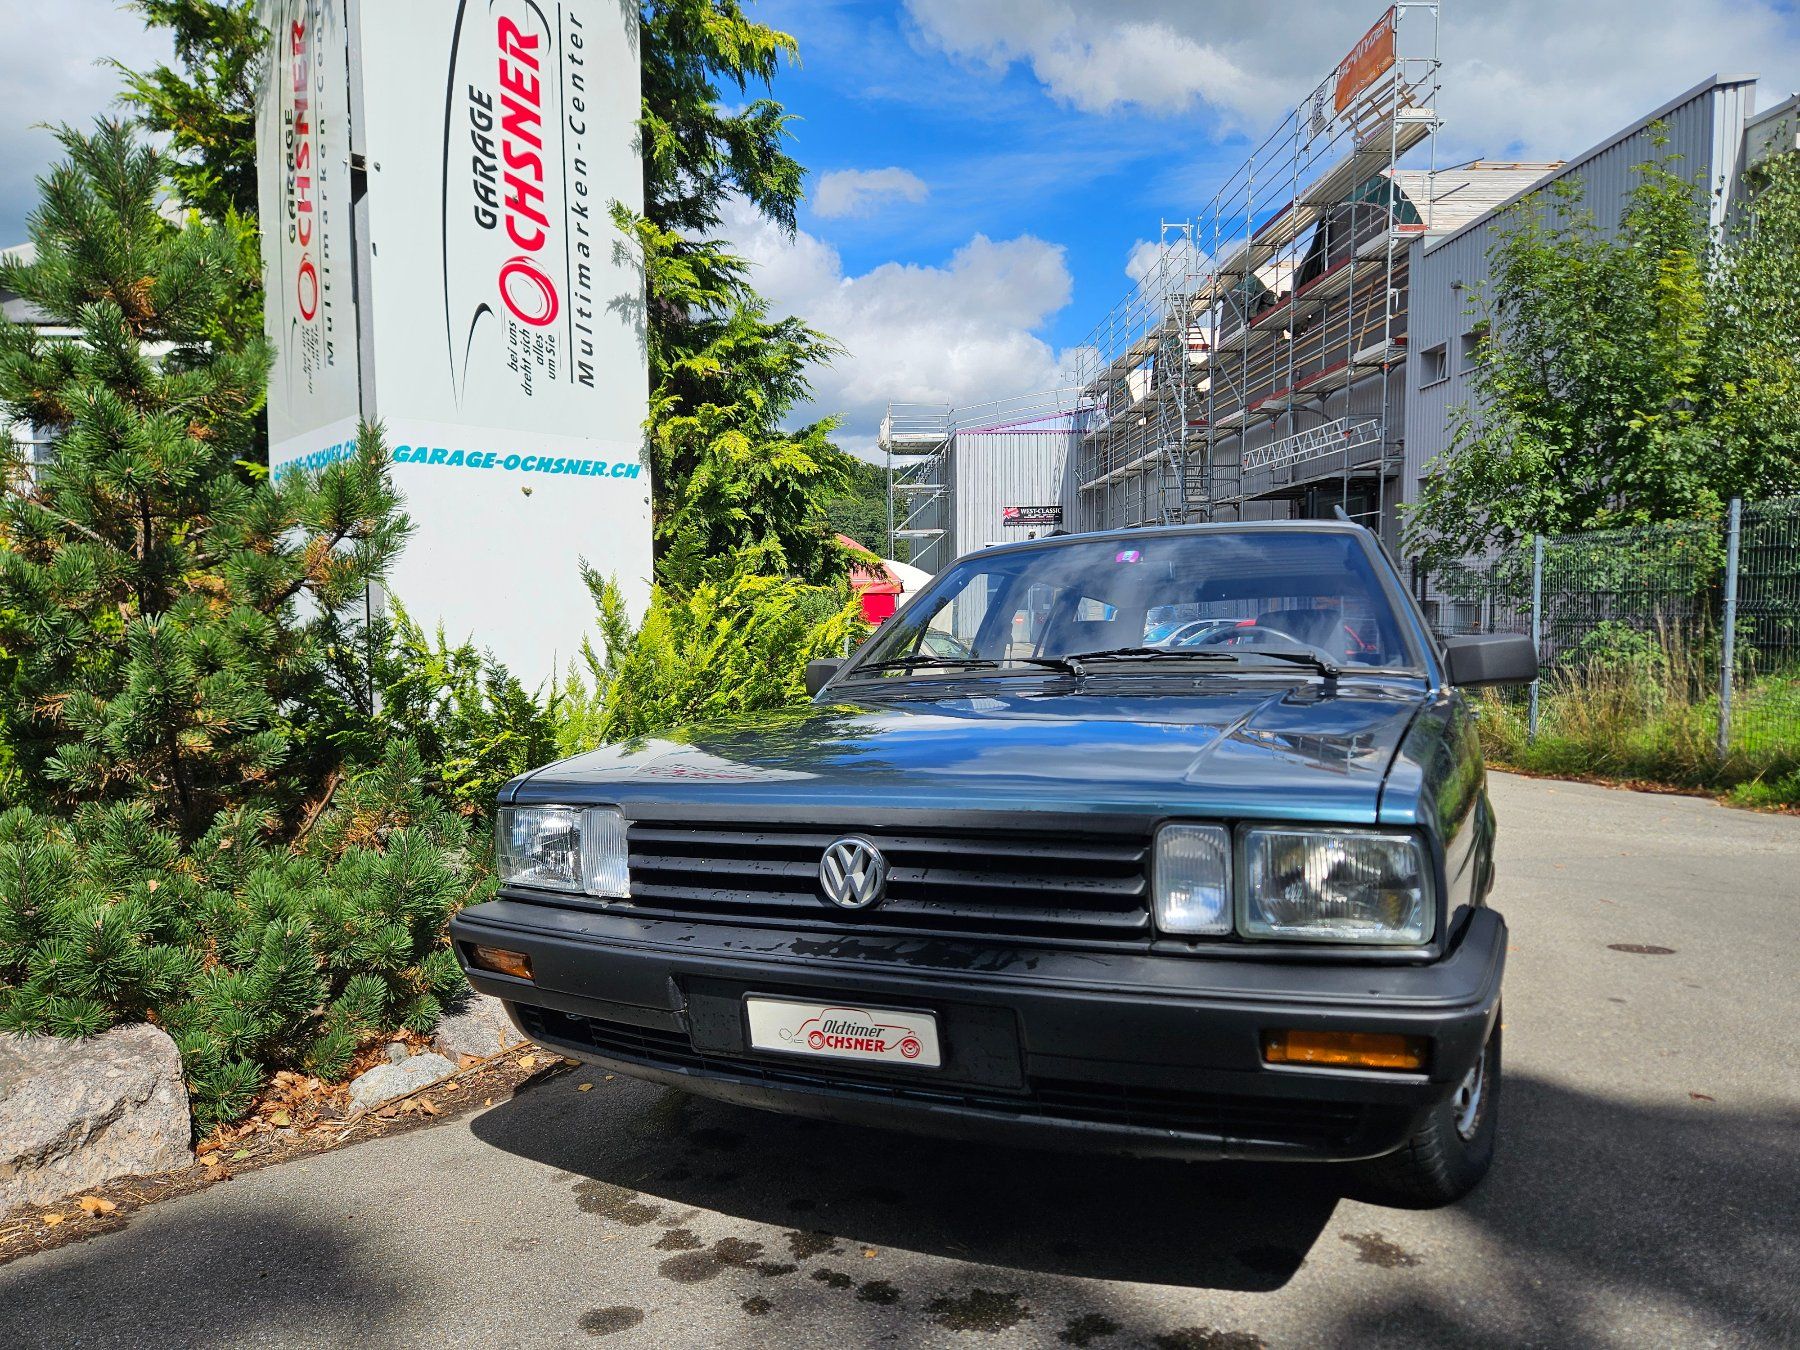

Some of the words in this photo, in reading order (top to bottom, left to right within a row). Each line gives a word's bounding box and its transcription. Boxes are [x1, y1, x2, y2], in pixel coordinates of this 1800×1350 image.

[469, 84, 500, 230] GARAGE
[497, 15, 559, 327] OCHSNER
[285, 109, 296, 244] GARAGE
[568, 12, 595, 388] Multimarken-Center
[509, 320, 517, 346] uns
[519, 328, 531, 356] sich
[533, 332, 544, 365] alles
[545, 334, 555, 356] Sie
[507, 346, 518, 373] bei
[548, 358, 556, 380] um
[520, 357, 532, 396] dreht
[393, 445, 641, 479] GARAGE-OCHSNER.CH
[821, 838, 883, 907] VW
[822, 1019, 885, 1038] Oldtimer
